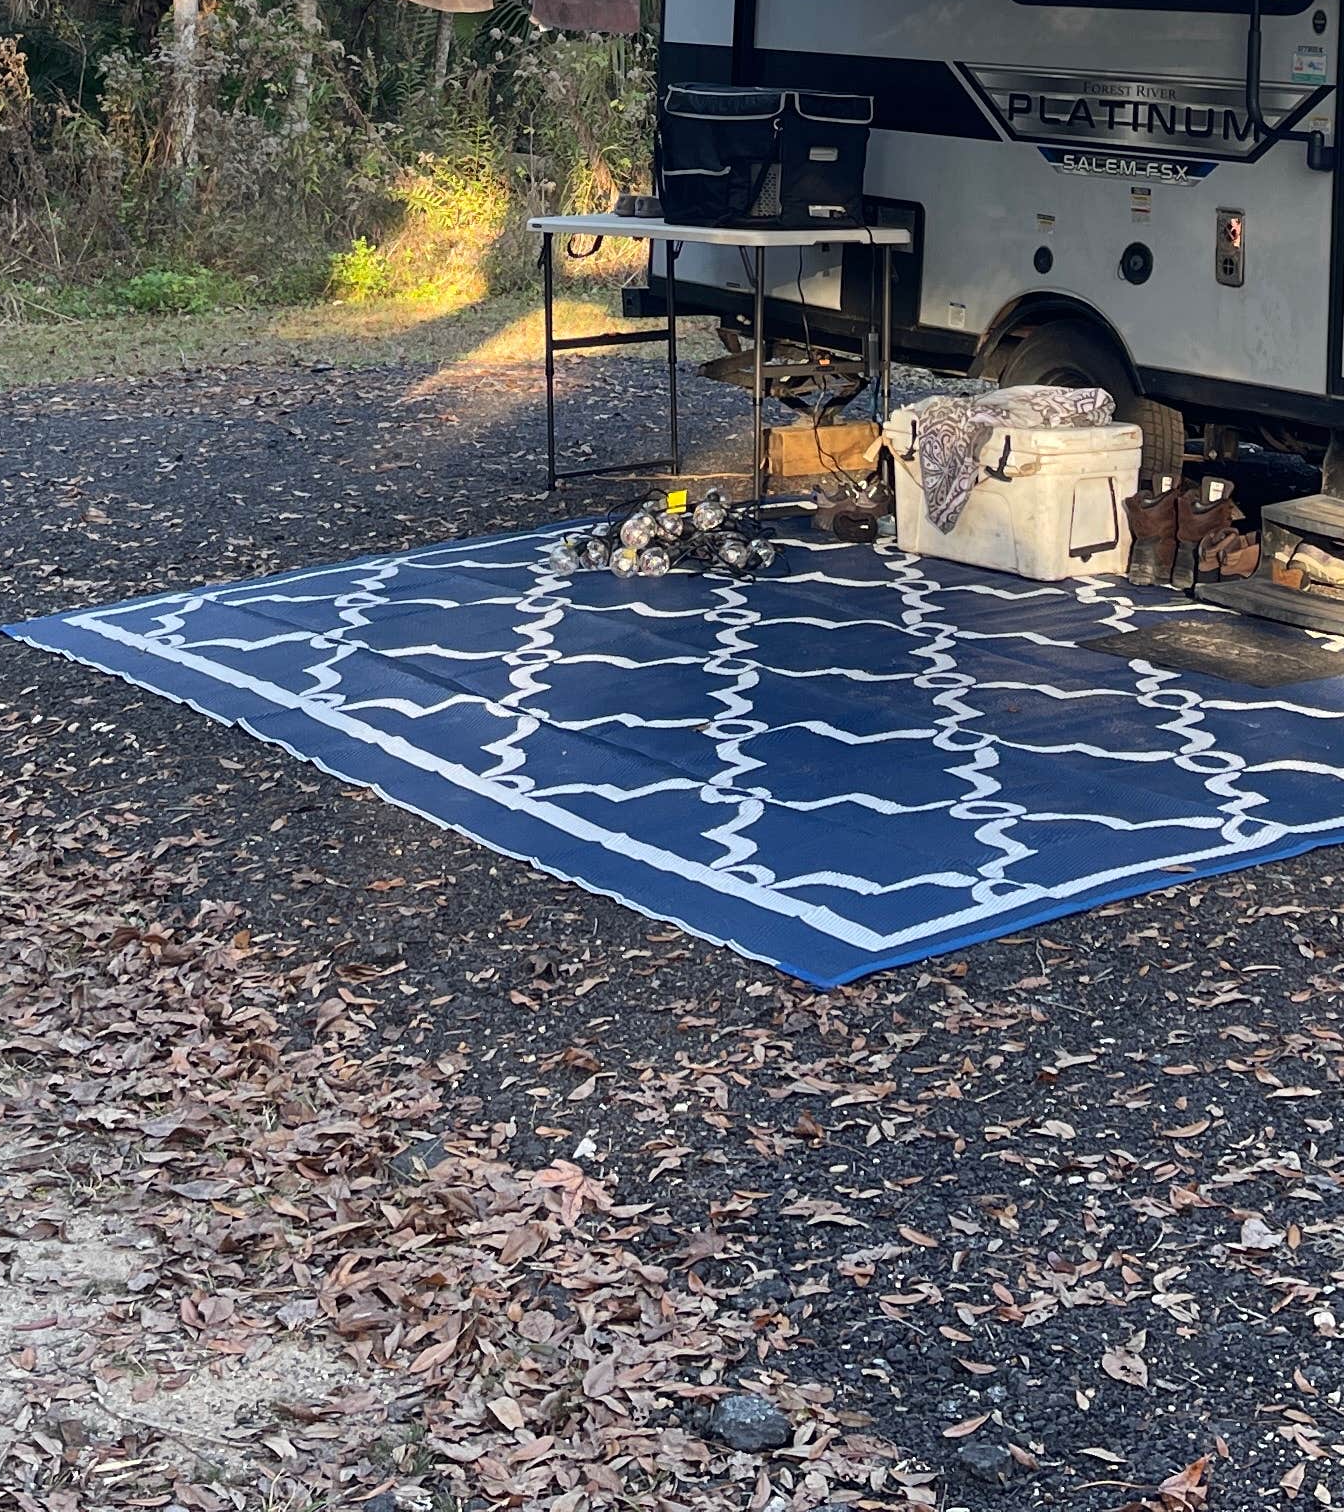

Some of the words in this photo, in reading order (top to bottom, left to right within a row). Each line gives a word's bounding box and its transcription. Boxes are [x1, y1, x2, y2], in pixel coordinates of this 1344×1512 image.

[1083, 81, 1132, 97] FOREST
[1136, 85, 1177, 101] RIVER
[1008, 92, 1260, 143] PLATINUM
[1063, 154, 1137, 177] SALEM
[1146, 161, 1189, 181] FSX
